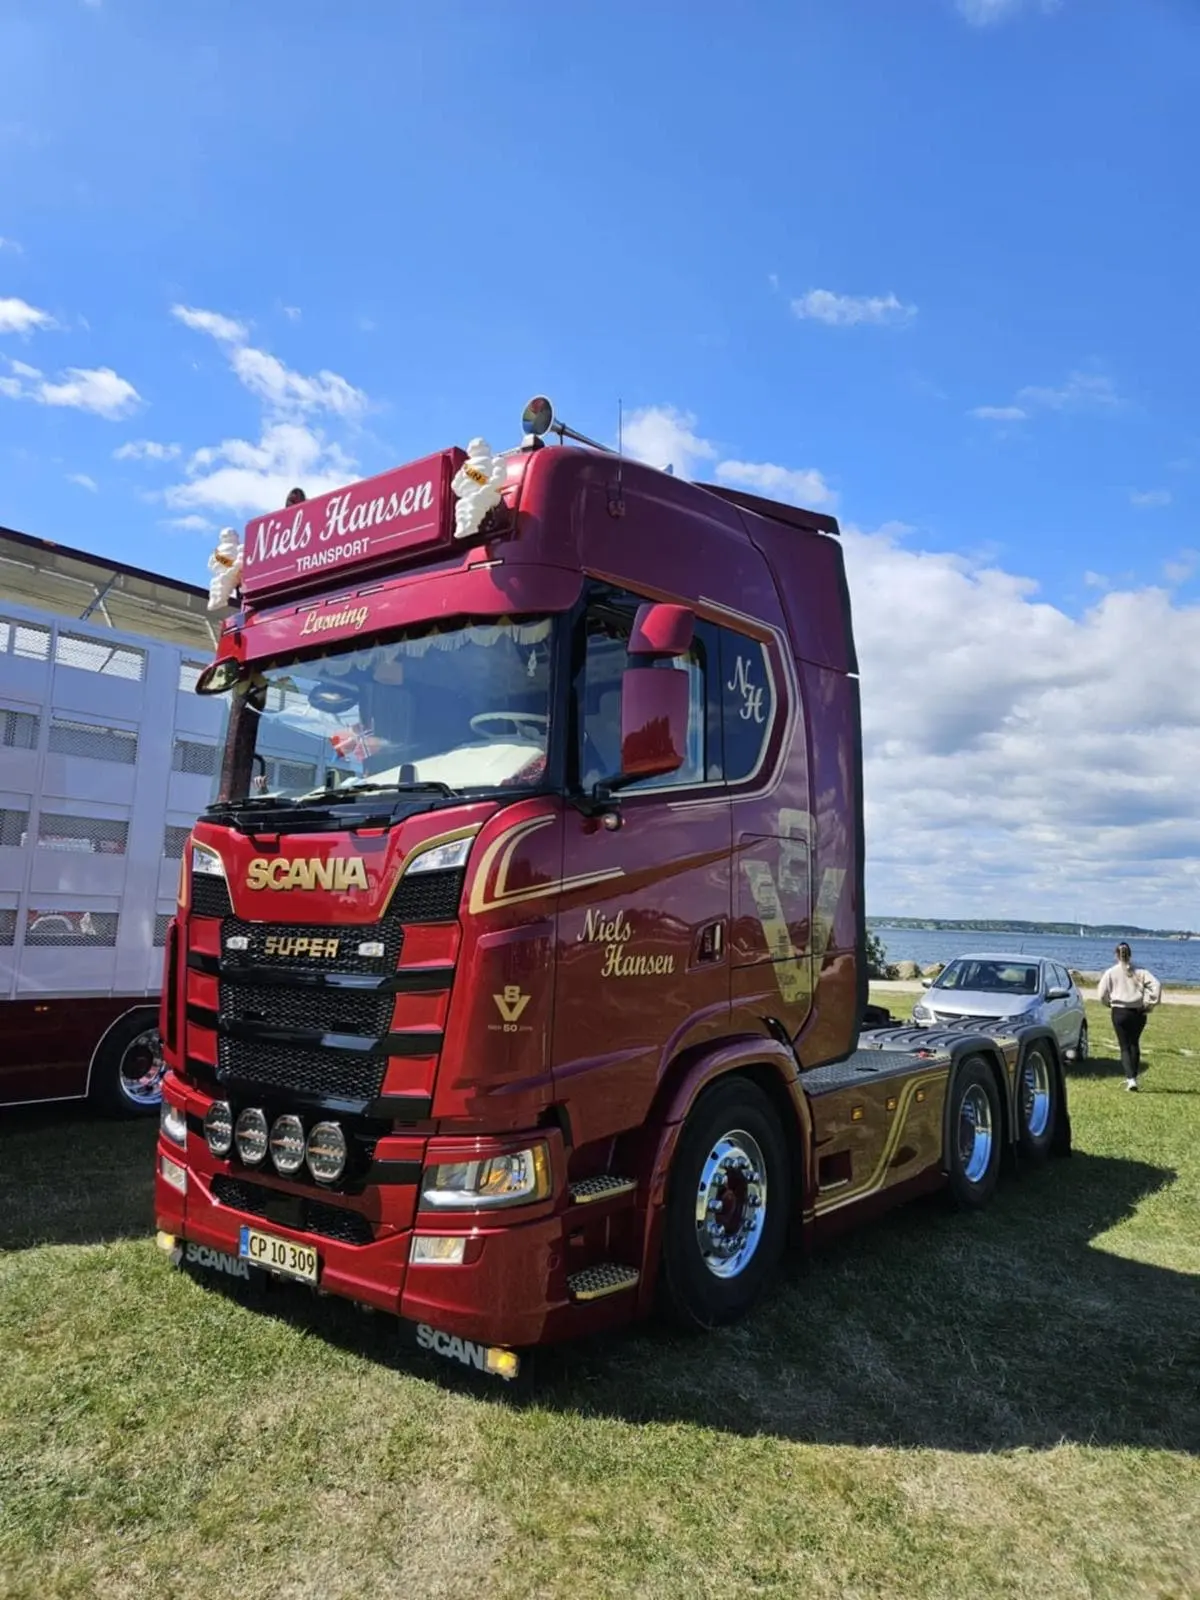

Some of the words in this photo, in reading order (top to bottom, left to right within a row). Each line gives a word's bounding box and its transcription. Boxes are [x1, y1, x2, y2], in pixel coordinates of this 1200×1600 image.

[246, 509, 312, 566] Niels
[320, 480, 434, 541] Hansen
[296, 537, 370, 572] TRANSPORT
[246, 856, 369, 891] SCANIA
[576, 908, 632, 942] Niels
[264, 936, 340, 958] SUPER
[601, 943, 675, 977] Hansen
[185, 1242, 250, 1280] SCANIA
[249, 1235, 267, 1257] CP
[271, 1242, 286, 1265] 10
[289, 1247, 315, 1276] 309
[416, 1322, 496, 1375] SCAN
